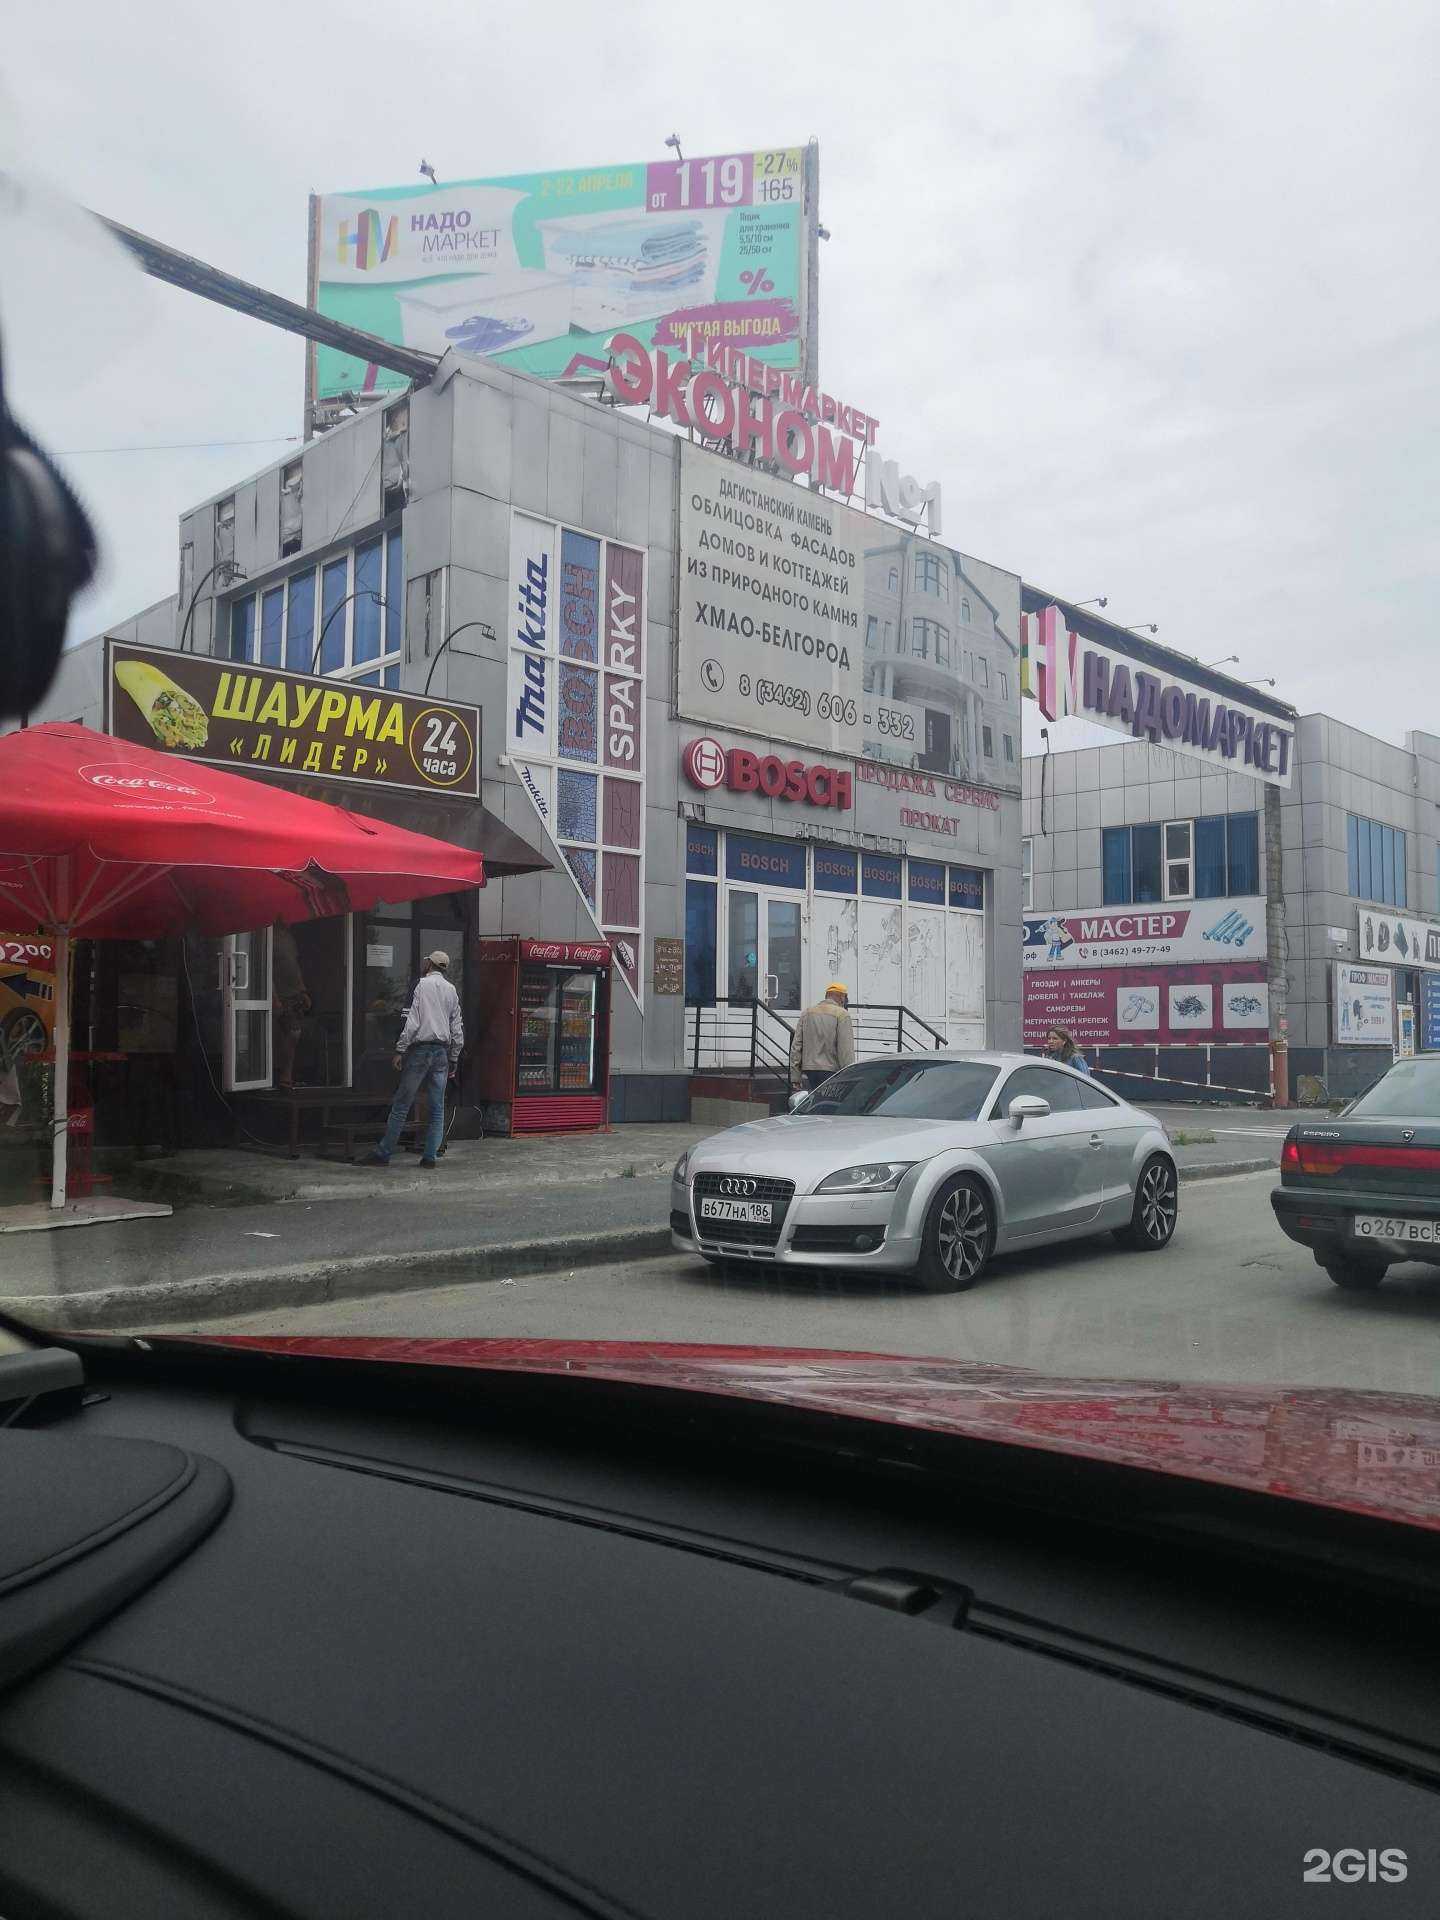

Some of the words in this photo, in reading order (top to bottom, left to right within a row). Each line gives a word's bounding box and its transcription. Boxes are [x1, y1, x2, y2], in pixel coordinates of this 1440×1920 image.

[757, 152, 799, 175] -27%
[676, 158, 744, 207] 119
[758, 177, 794, 203] 165
[410, 209, 472, 233] НАДО
[422, 229, 501, 253] МАРКЕТ
[669, 318, 721, 340] ЧИСТАЯ
[722, 315, 782, 337] ВЫГОДА
[687, 325, 881, 447] ГИПЕРМАРКЕТ
[602, 332, 855, 498] ЭКОНОМ
[719, 477, 796, 523] ДАГИСТАНСКИЙ
[796, 509, 833, 537] КАМЕНЬ
[690, 493, 784, 543] ОБЛИЦОВКА
[790, 531, 857, 569] ФАСАДОВ
[698, 529, 756, 563] ДОМОВ
[758, 550, 770, 569] И
[772, 554, 850, 596] КОТТЕДЖЕЙ
[687, 556, 708, 579] ИЗ
[711, 568, 810, 612] ПРИРОДНОГО
[812, 600, 859, 629] КАМНЯ
[515, 552, 549, 740] makita
[695, 601, 851, 672] ХМАО-БЕЛГОРОД
[561, 561, 598, 752] BOSCH
[608, 578, 637, 762] SPARKY
[738, 673, 752, 697] 8
[756, 678, 812, 716] (3462)
[212, 672, 405, 746] ШАУРМА
[1083, 650, 1295, 777] НАДОМАРКЕТ
[422, 717, 457, 756] 24
[422, 757, 457, 777] часа
[729, 748, 853, 811] BOSCH
[92, 774, 200, 796] Coca-Cola
[522, 765, 551, 819] makita
[856, 760, 938, 798] ПРОДАЖА
[943, 782, 1002, 812] СЕРВИС
[900, 807, 961, 837] ПРОКАТ
[687, 842, 716, 857] OSCH
[740, 851, 791, 874] BOSCH
[815, 860, 855, 878] BOSCH
[863, 868, 902, 885] BOSCH
[910, 876, 945, 893] BOSCH
[950, 882, 984, 898] BOSCH
[1081, 914, 1176, 941] МАСТЕР
[616, 941, 636, 972] SPARKY
[1100, 947, 1129, 958] (3462)
[1131, 945, 1171, 955] 49-77-49
[1031, 980, 1060, 988] ГВОЗДИ
[1070, 979, 1101, 987] АНКЕРЫ
[1070, 992, 1105, 1000] ТАКЕЛАЖ
[1024, 1017, 1077, 1026] МЕТРИЧЕСКИЙ
[1078, 1017, 1109, 1025] КРЕПЕЖ
[1046, 1005, 1086, 1013] САМОРЕЗЫ
[1023, 1029, 1077, 1039] СПЕЦИЙ
[1079, 1030, 1110, 1038] КРЕПЕЖ
